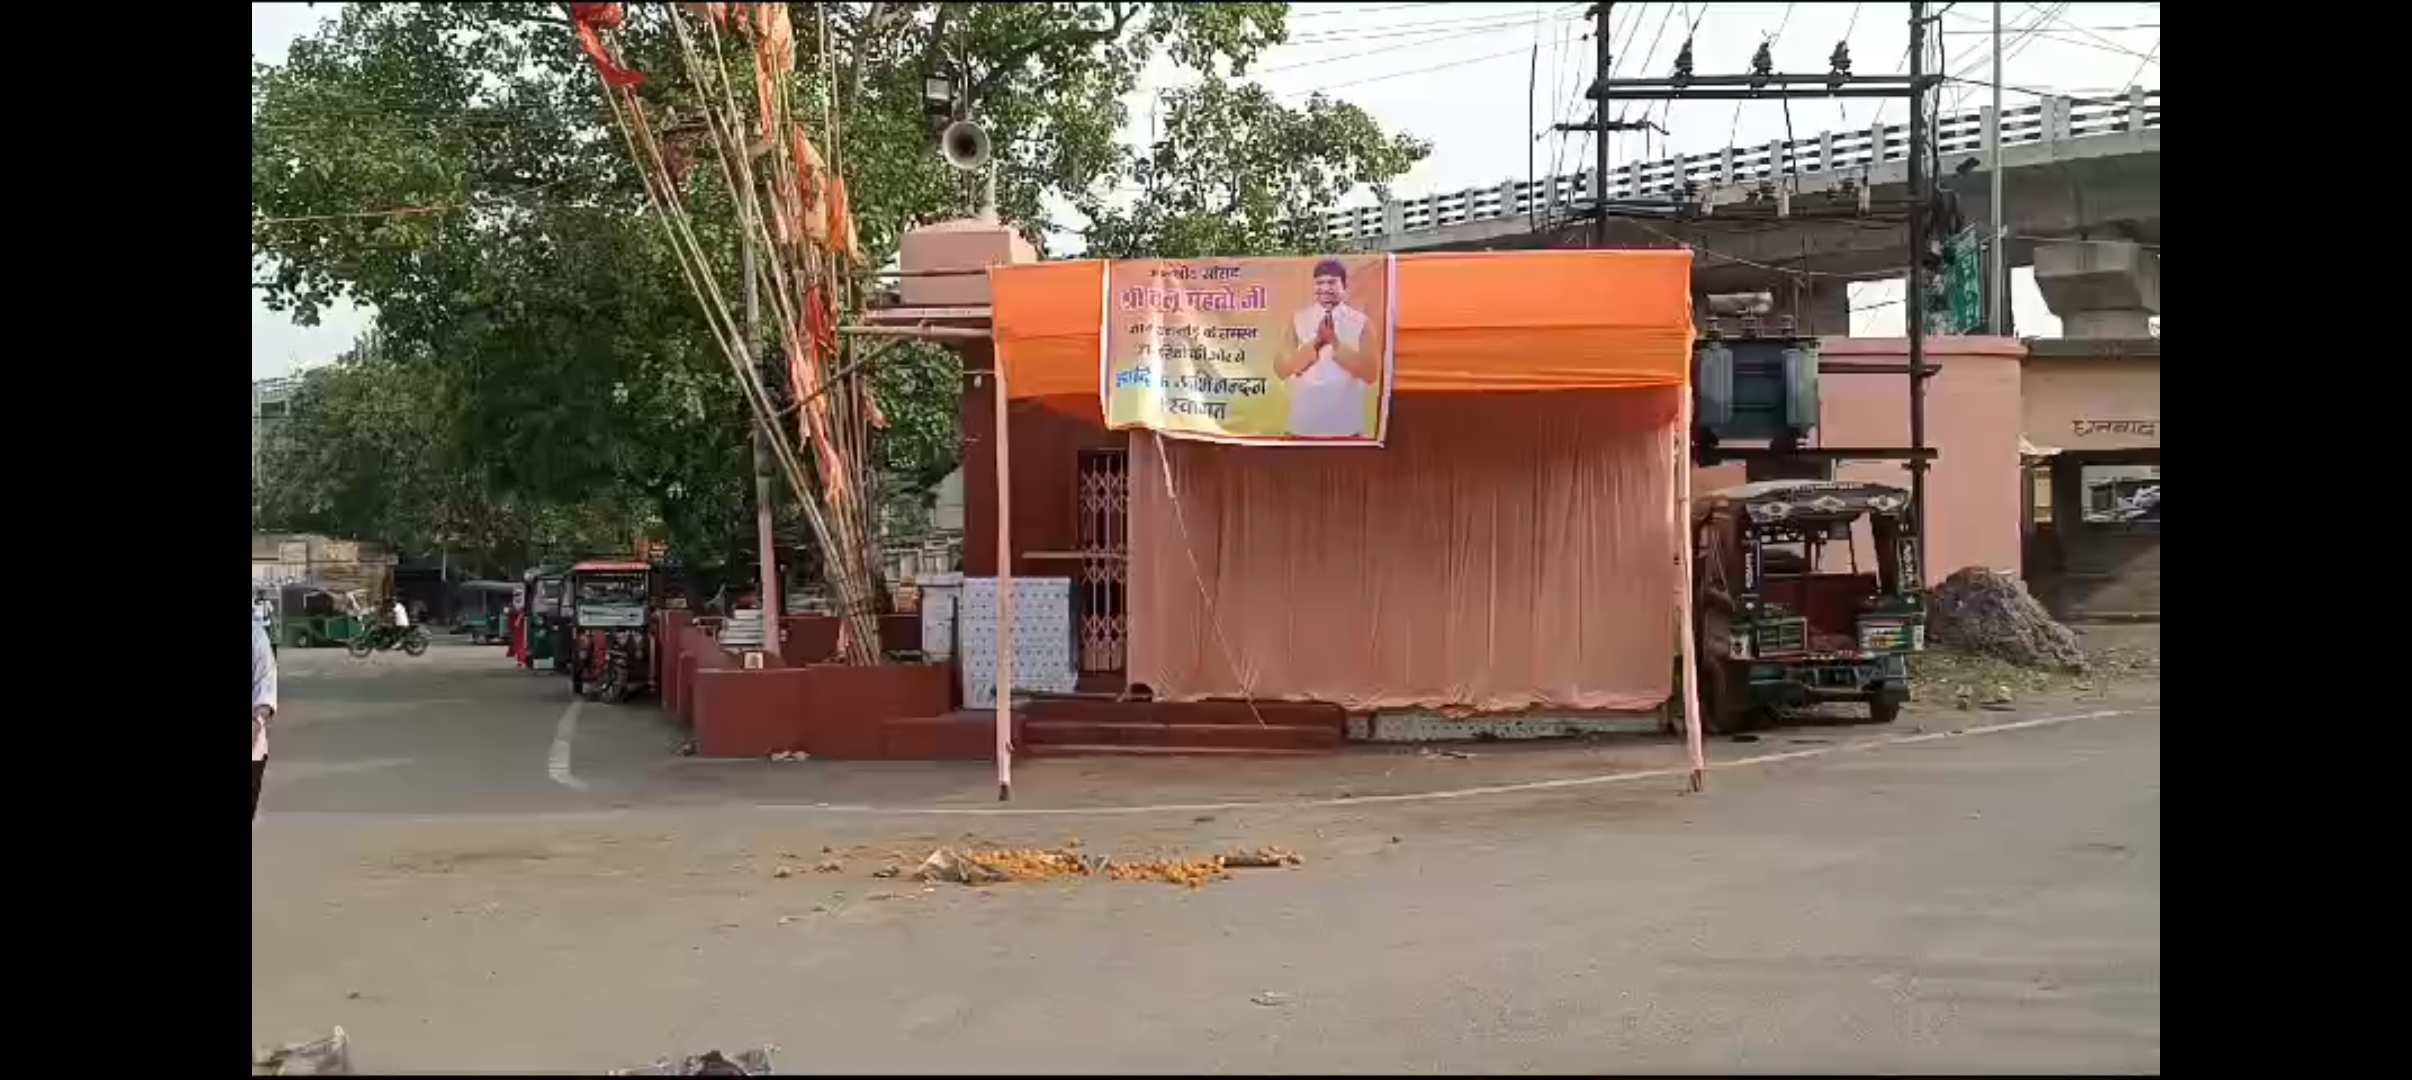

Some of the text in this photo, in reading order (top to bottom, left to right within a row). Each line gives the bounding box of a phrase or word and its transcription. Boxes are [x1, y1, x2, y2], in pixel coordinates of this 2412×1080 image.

[1118, 285, 1145, 311] श्री
[1185, 284, 1237, 312] महतो
[1240, 285, 1269, 311] जी
[1132, 341, 1187, 361] नारिकों
[2071, 418, 2156, 439] धनबाद
